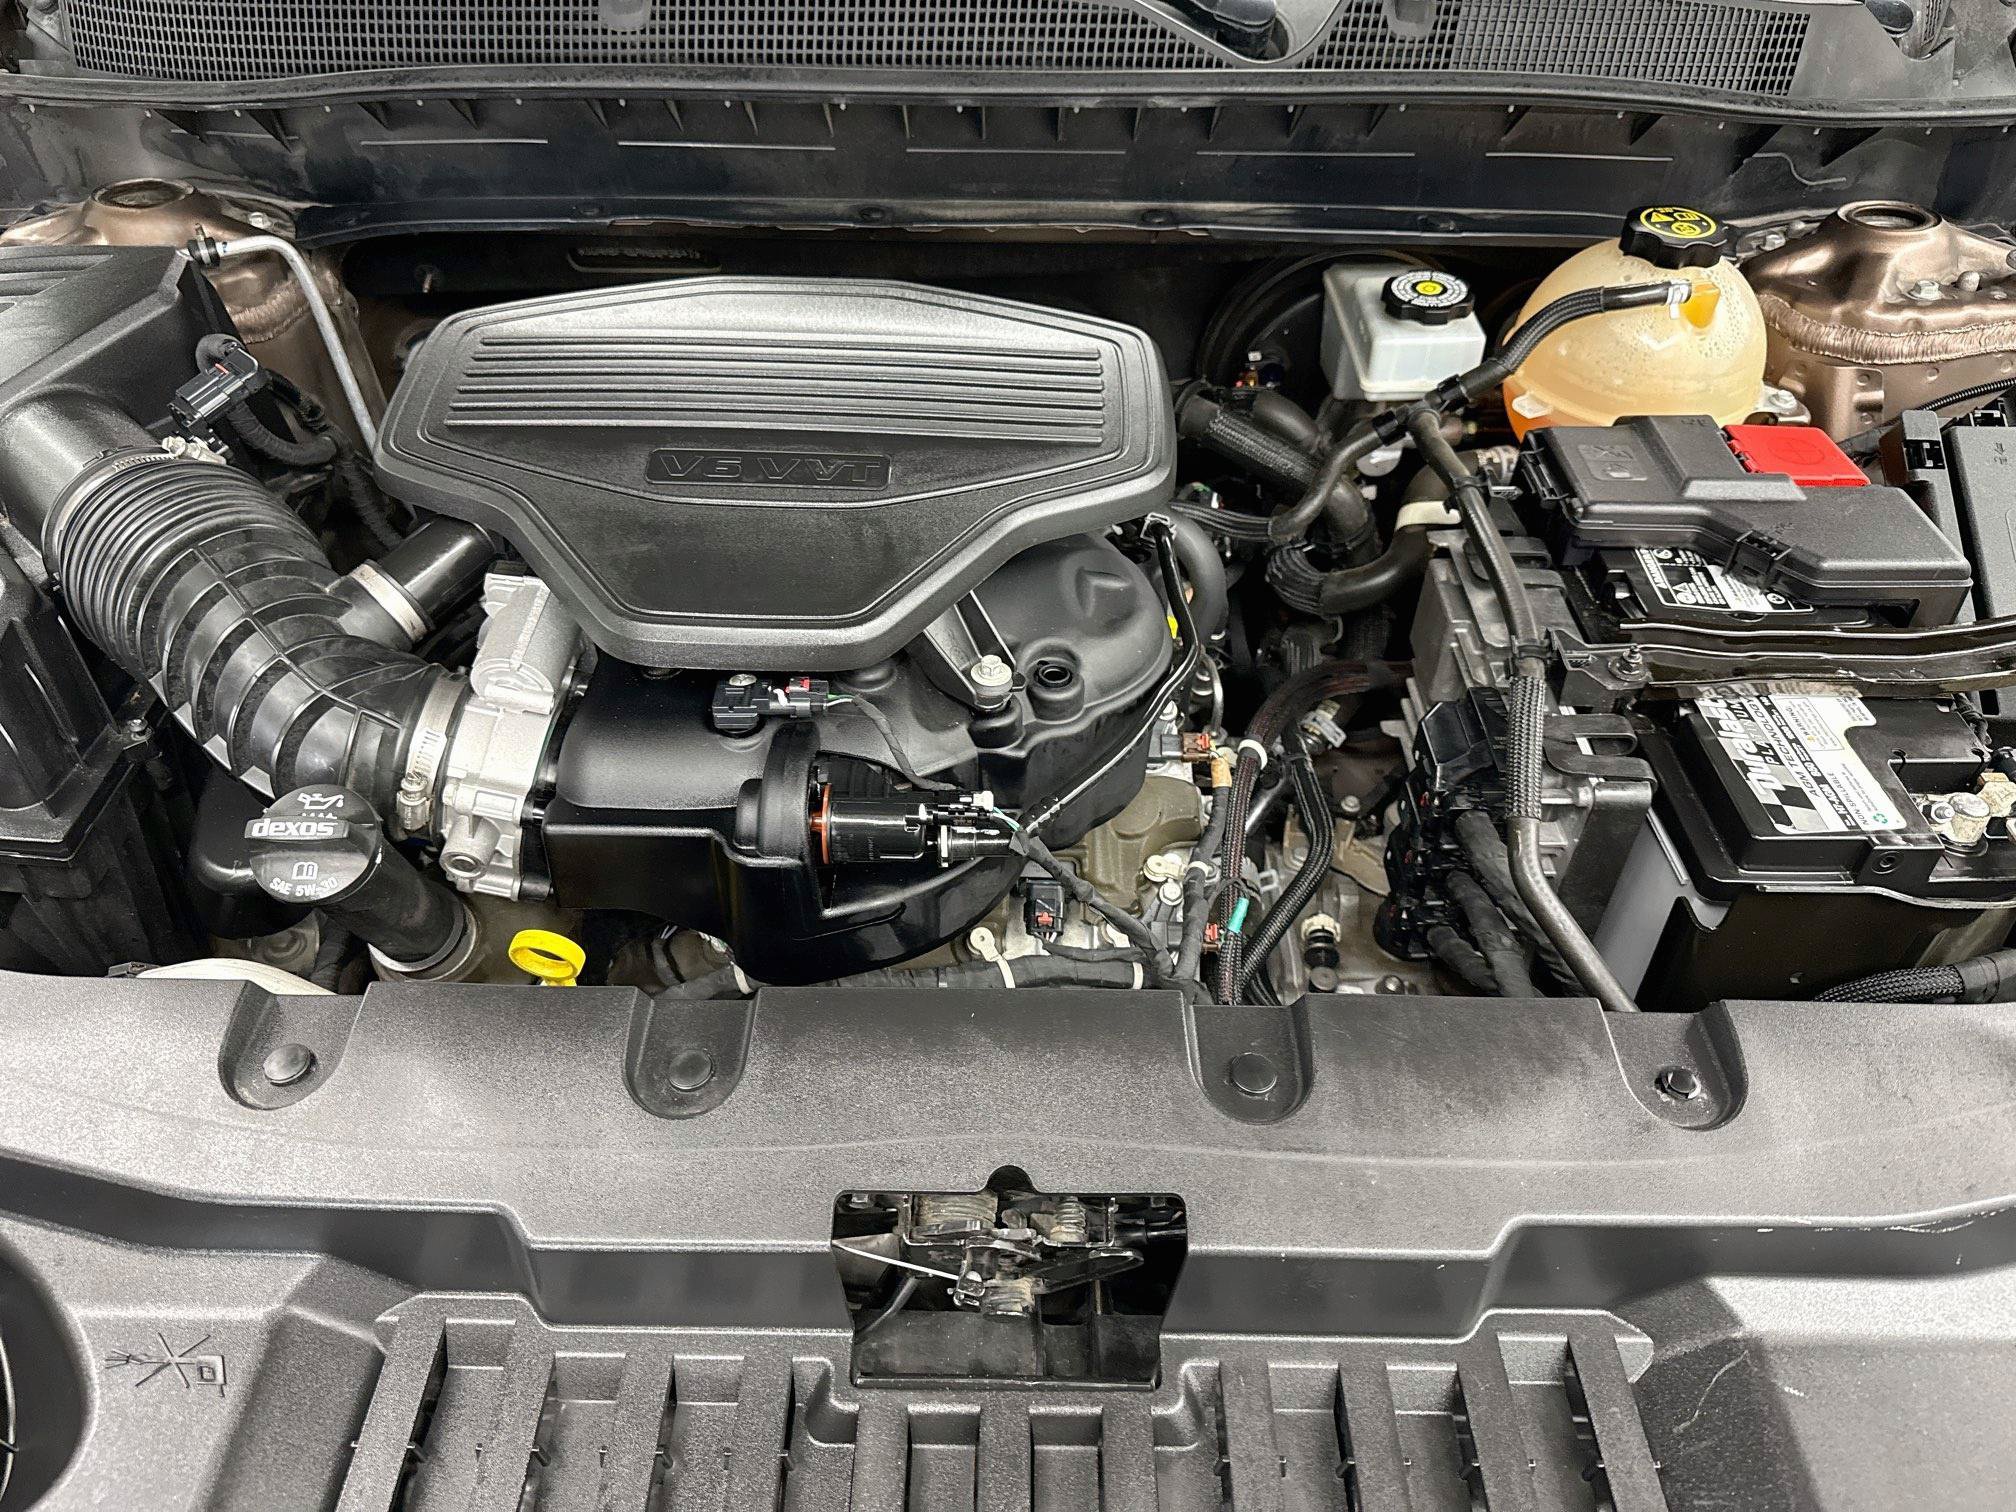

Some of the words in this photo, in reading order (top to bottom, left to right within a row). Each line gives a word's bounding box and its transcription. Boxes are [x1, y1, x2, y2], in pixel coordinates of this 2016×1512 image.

[659, 455, 742, 478] V6
[757, 457, 881, 482] VVT
[1699, 696, 1787, 796] Duralast
[1726, 698, 1780, 766] PLATINUM
[1746, 698, 1799, 767] TECHNOLOGY
[1795, 770, 1821, 798] AGM
[250, 818, 339, 837] dexos
[269, 876, 294, 896] SAE
